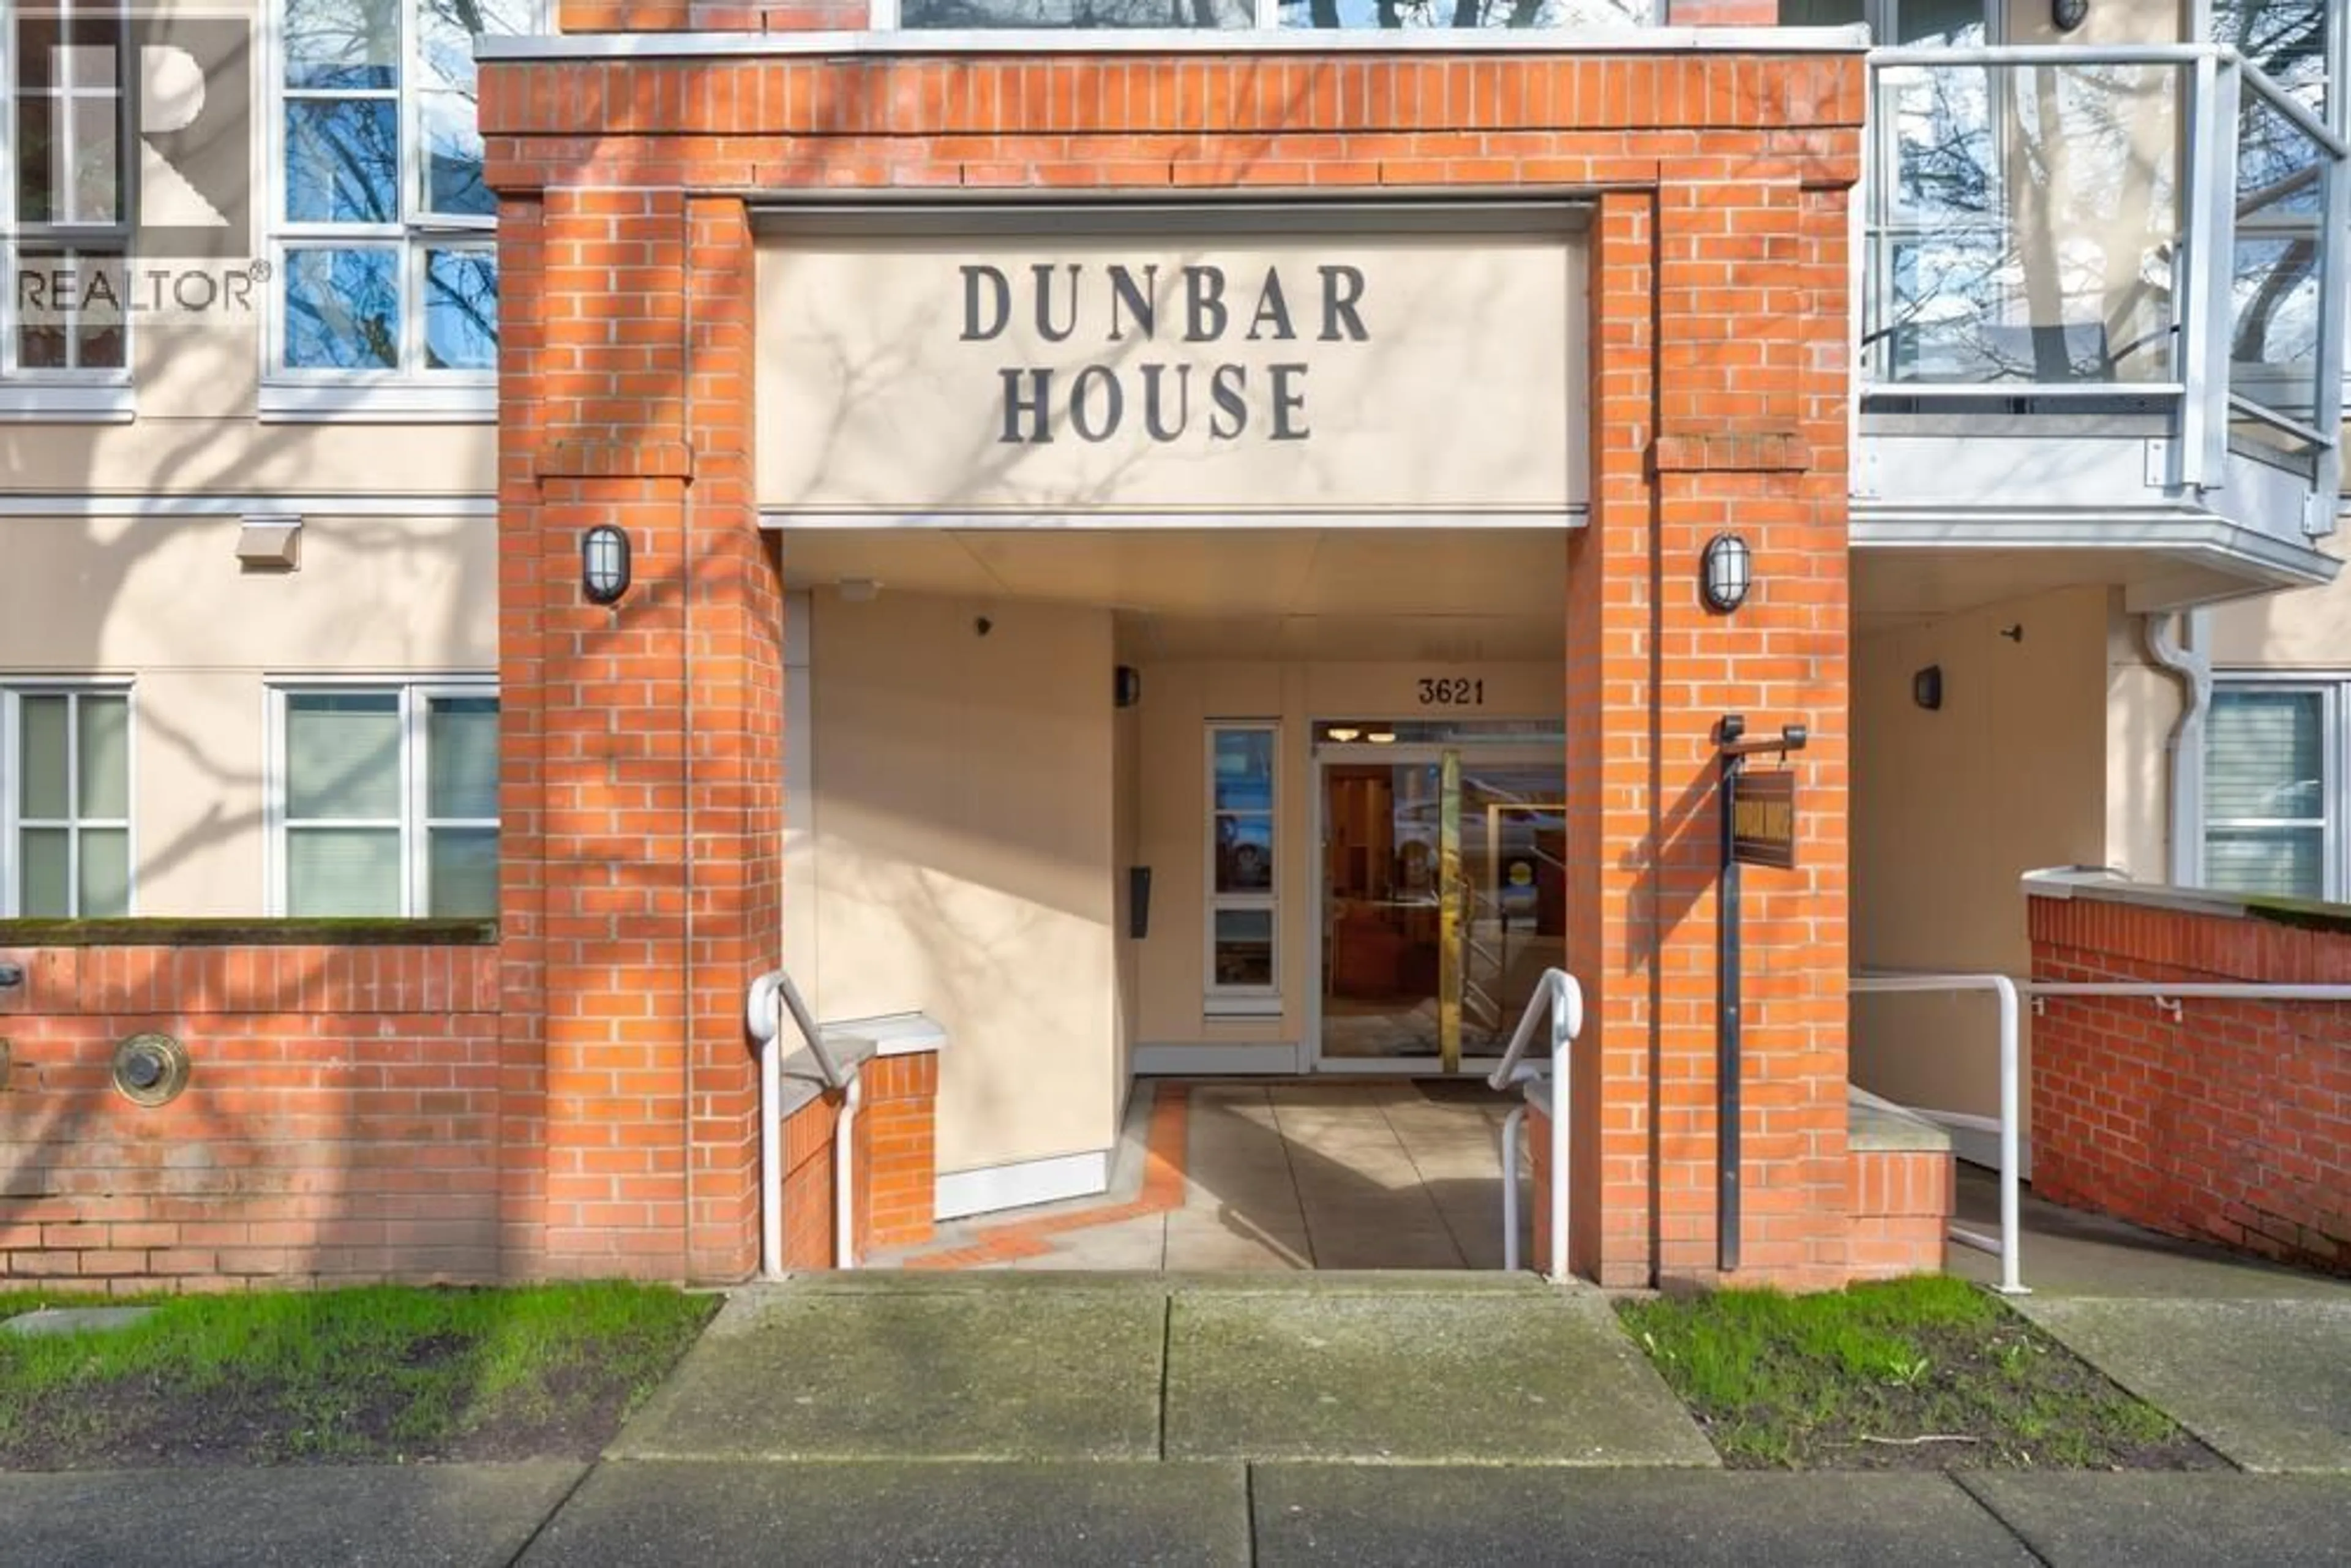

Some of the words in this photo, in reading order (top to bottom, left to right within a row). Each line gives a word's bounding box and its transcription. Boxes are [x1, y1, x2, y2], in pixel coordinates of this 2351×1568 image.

[959, 263, 1371, 342] DUNBAR
[998, 363, 1311, 443] HOUSE
[1418, 678, 1483, 705] 3621
